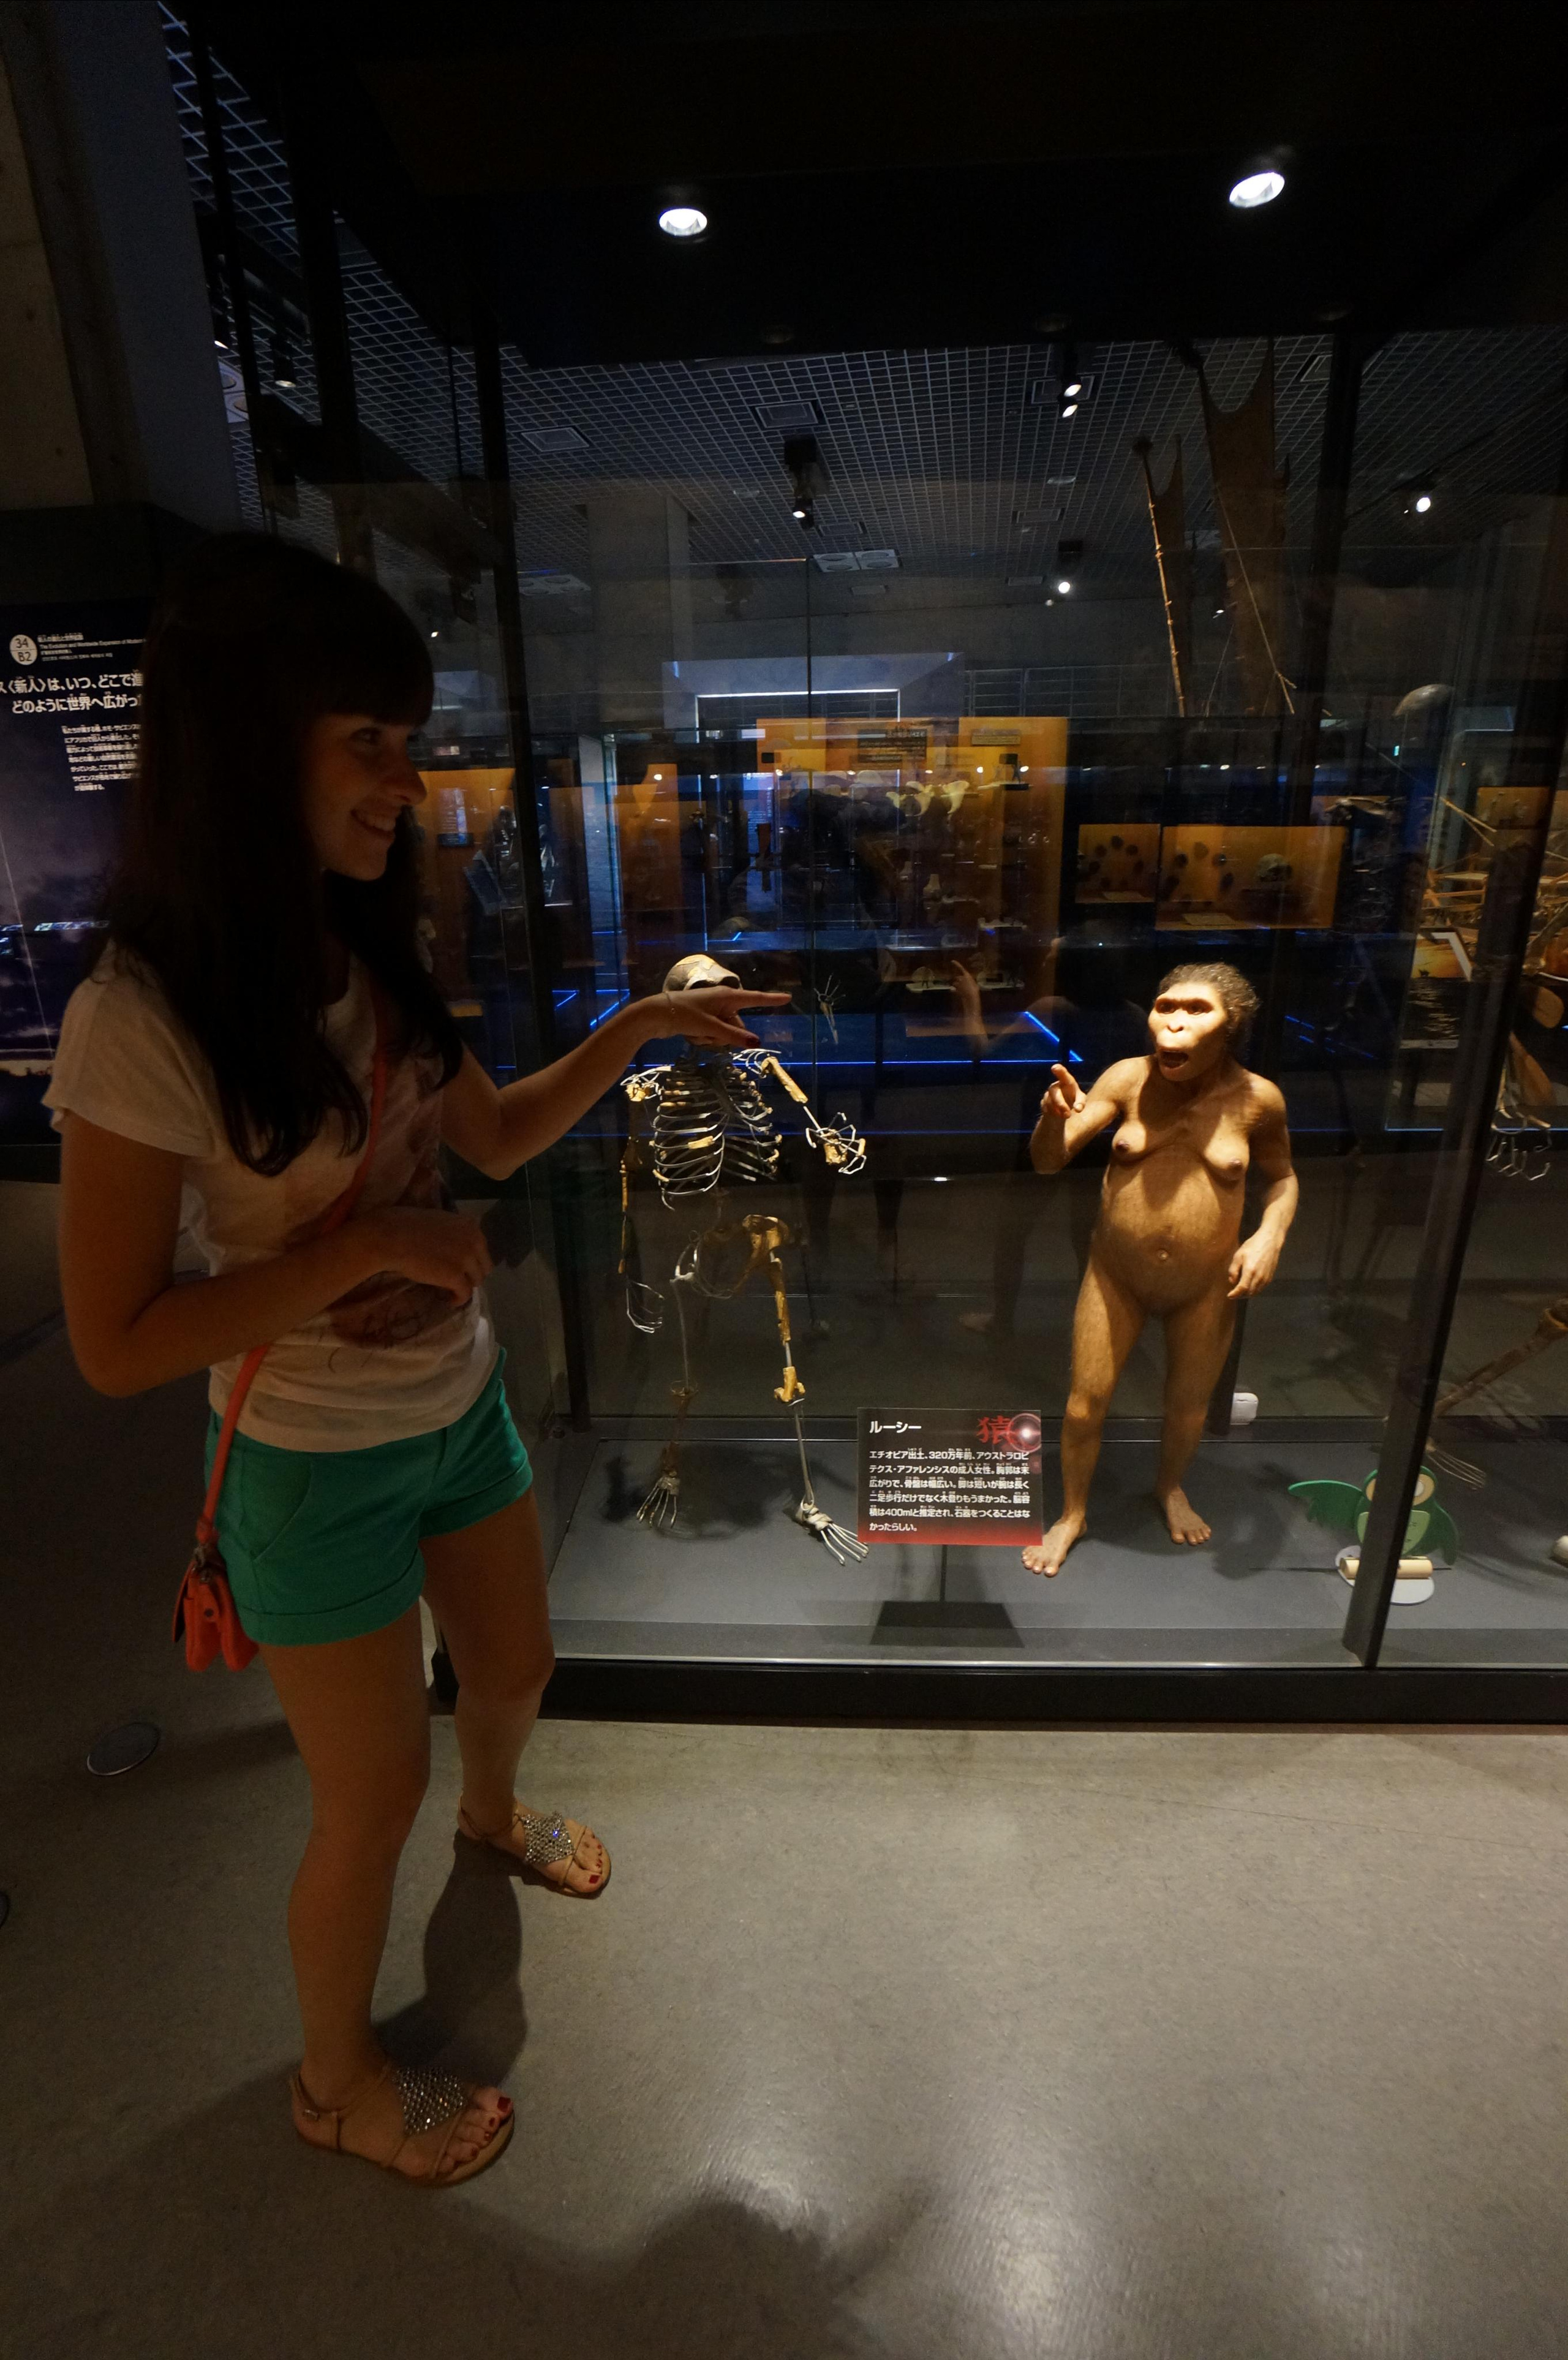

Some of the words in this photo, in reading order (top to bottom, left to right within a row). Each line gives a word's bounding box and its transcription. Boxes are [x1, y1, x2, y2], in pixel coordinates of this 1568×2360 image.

[15, 638, 29, 648] 34
[18, 651, 32, 662] B2
[869, 1420, 922, 1434] ルーシー
[976, 1415, 1015, 1445] 猿
[869, 1522, 918, 1532] かったらしい。
